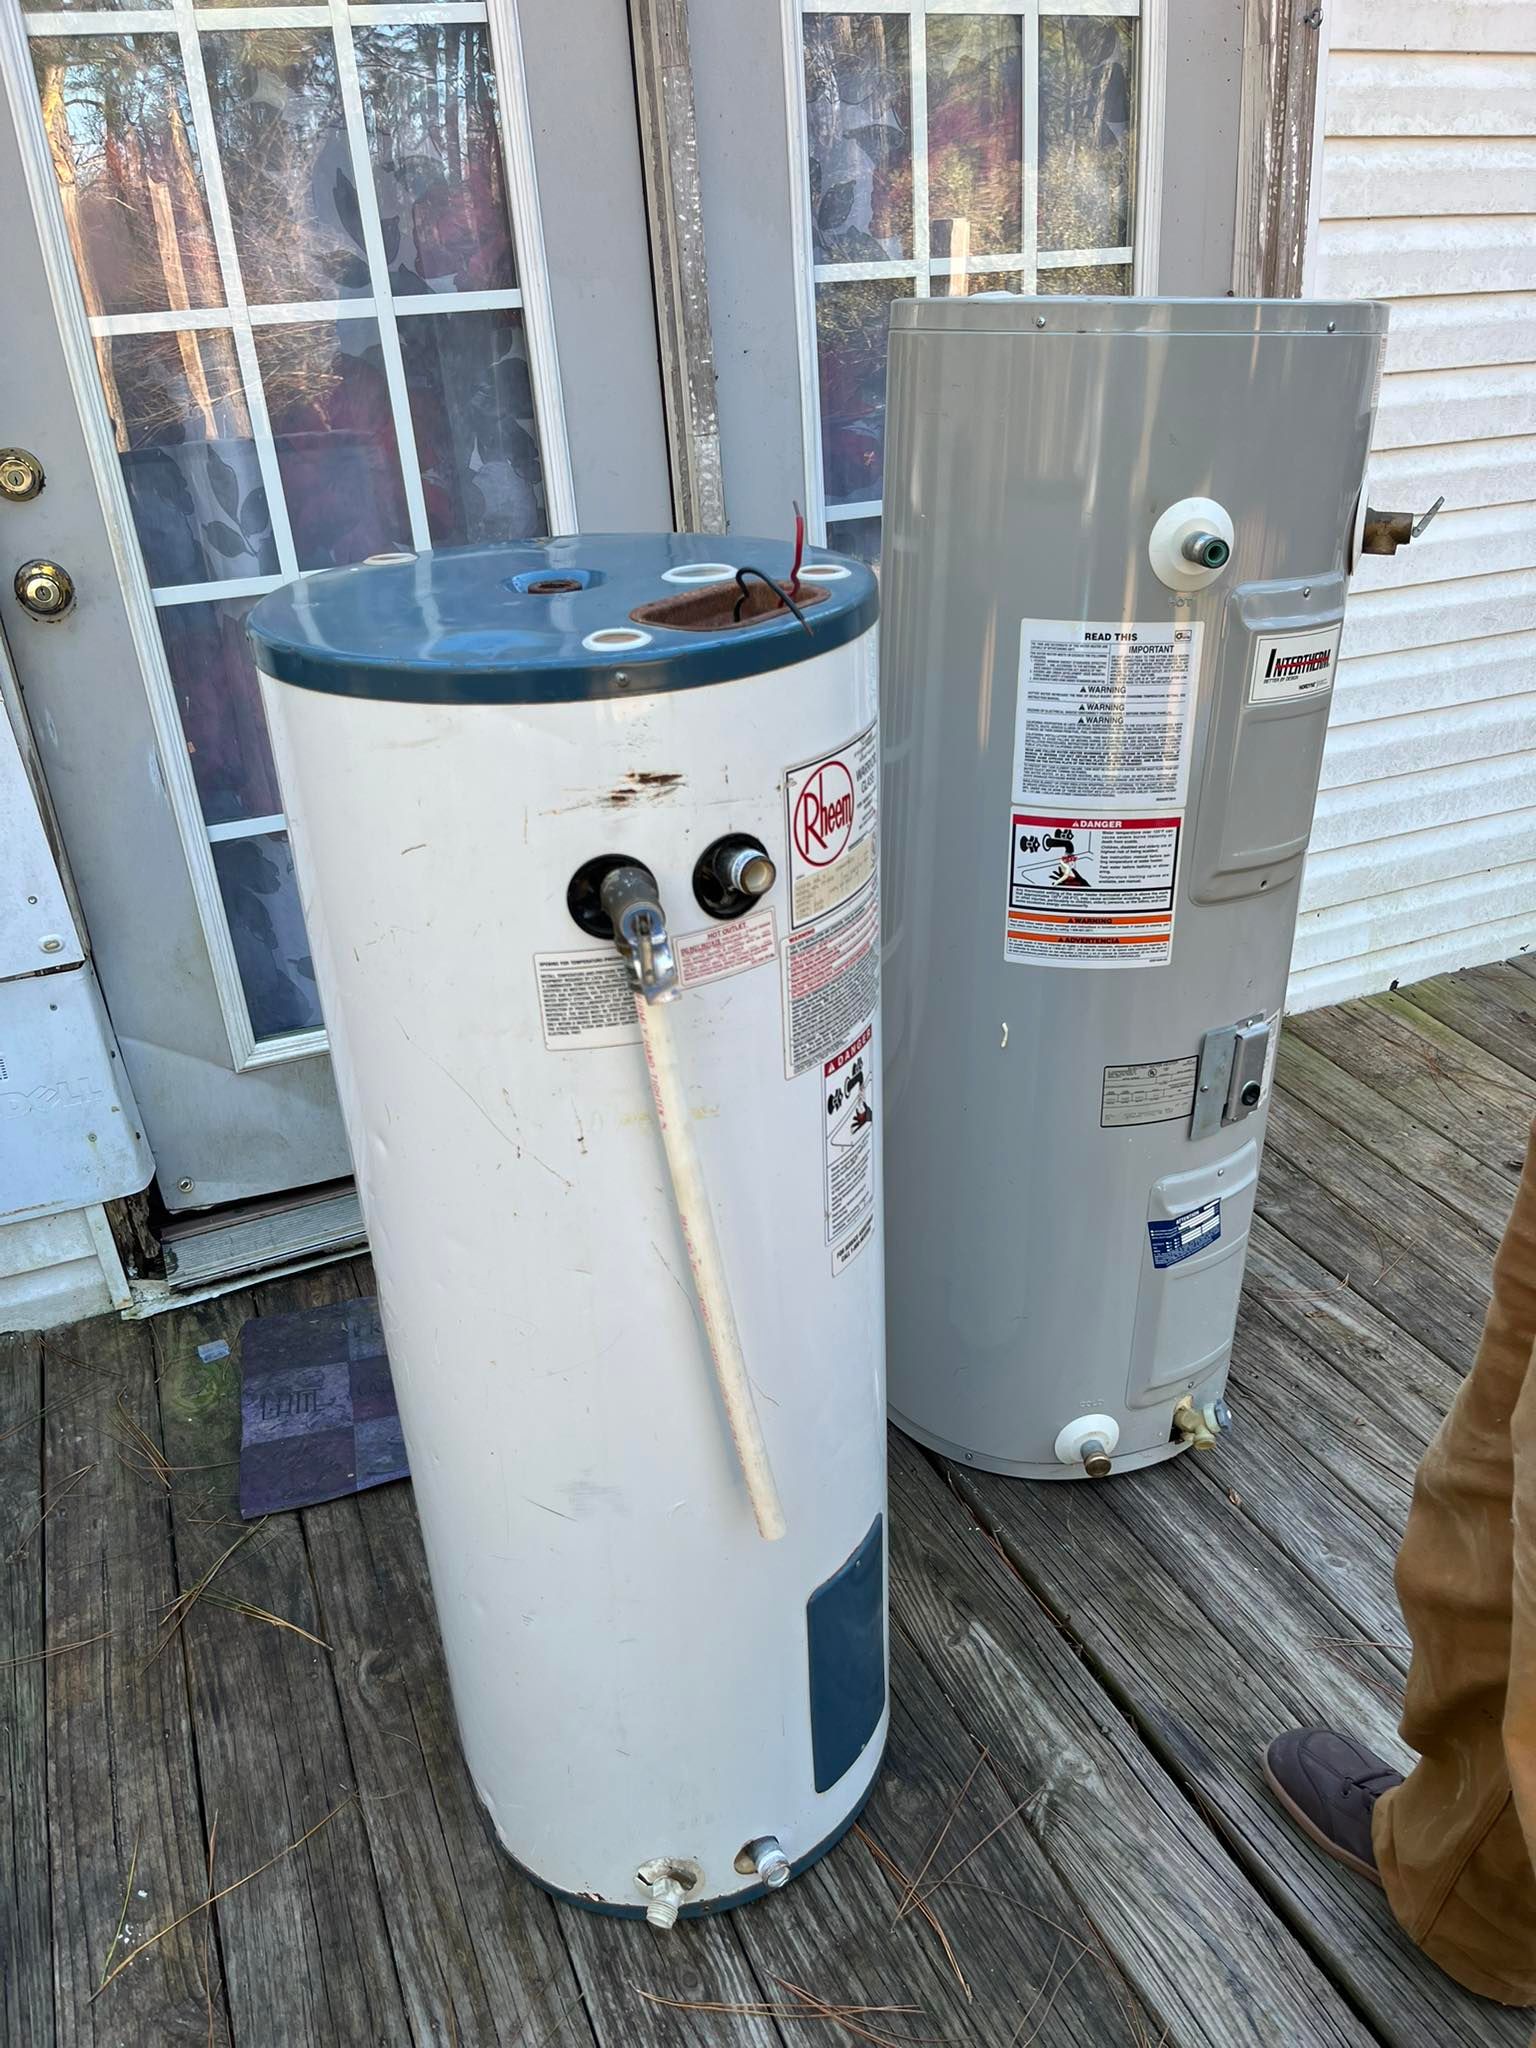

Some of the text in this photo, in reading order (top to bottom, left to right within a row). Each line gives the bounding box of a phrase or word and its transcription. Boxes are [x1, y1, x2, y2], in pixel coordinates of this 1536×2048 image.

[1085, 633, 1138, 641] READ THIS
[1129, 645, 1174, 654] IMPORTANT
[1265, 648, 1331, 678] INTERTHERM
[1088, 686, 1126, 694] WARNING
[804, 772, 852, 856] Rheem
[1080, 820, 1122, 828] DANGER
[837, 1027, 872, 1067] DANGER
